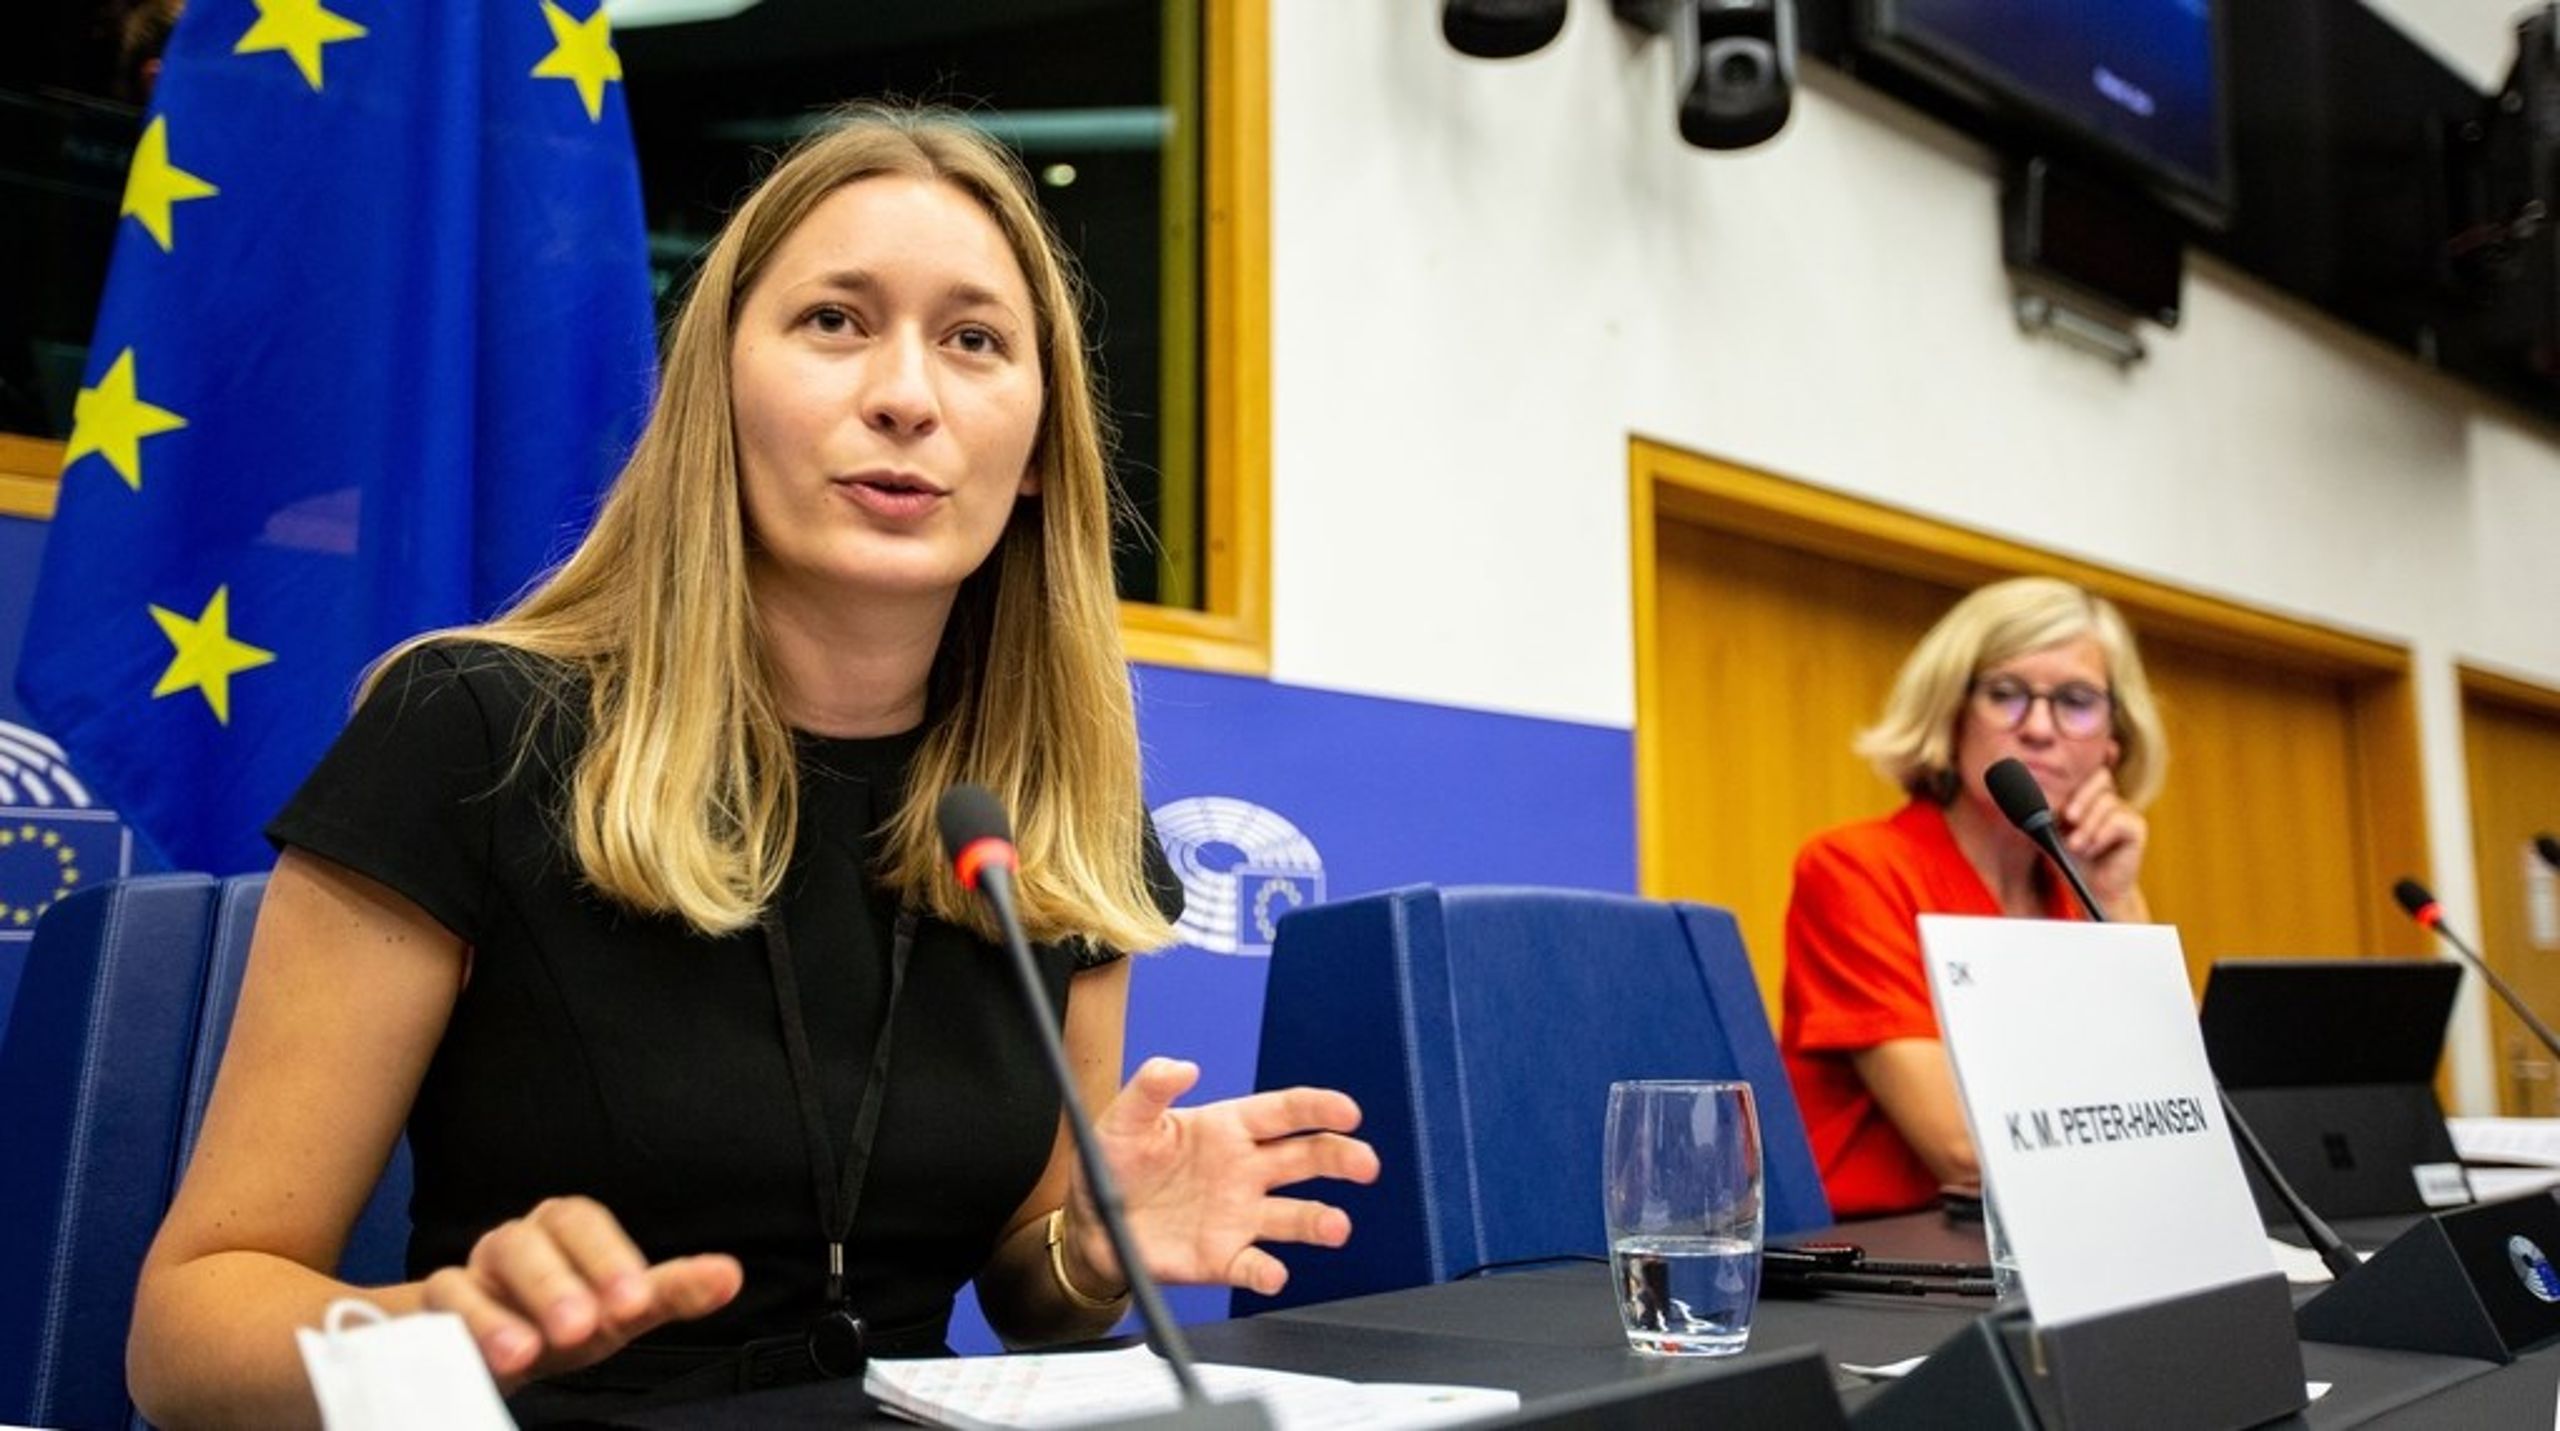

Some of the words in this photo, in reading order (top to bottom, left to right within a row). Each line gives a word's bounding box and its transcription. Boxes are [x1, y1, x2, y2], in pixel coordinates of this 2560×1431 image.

[1948, 962, 1973, 985] DK
[2006, 1111, 2030, 1152] K.
[2031, 1108, 2060, 1147] M.
[2060, 1097, 2208, 1145] PETER-HANSEN
